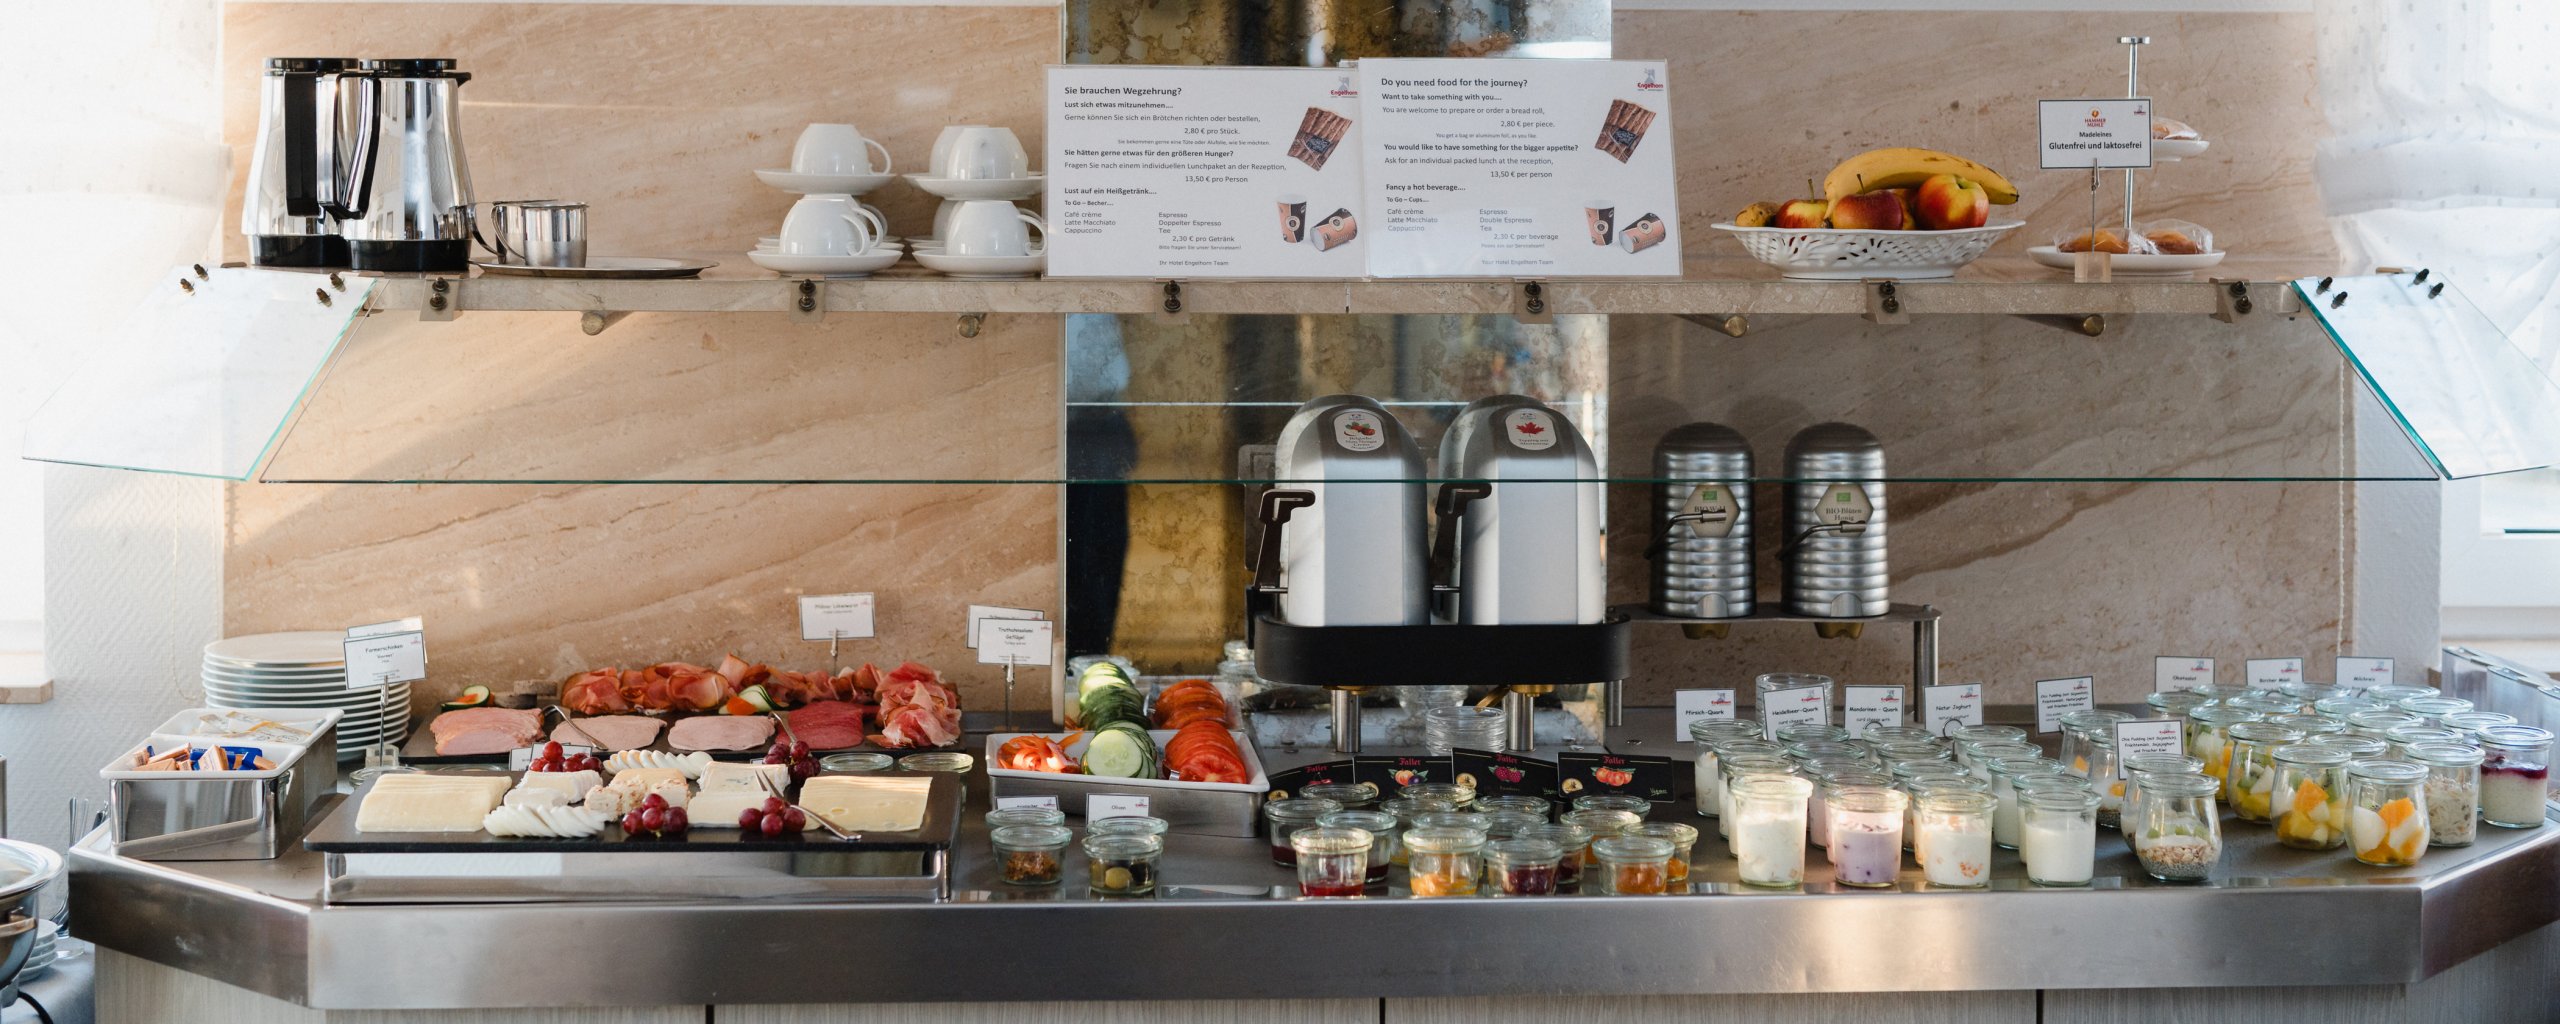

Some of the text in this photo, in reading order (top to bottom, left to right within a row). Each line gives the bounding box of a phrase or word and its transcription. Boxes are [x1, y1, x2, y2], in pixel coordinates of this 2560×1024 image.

[1490, 79, 1528, 88] journey?
[1123, 87, 1182, 96] Wegzehrung?
[1398, 758, 1422, 766] Faller
[1496, 753, 1518, 764] Faller
[1603, 756, 1626, 765] Faller
